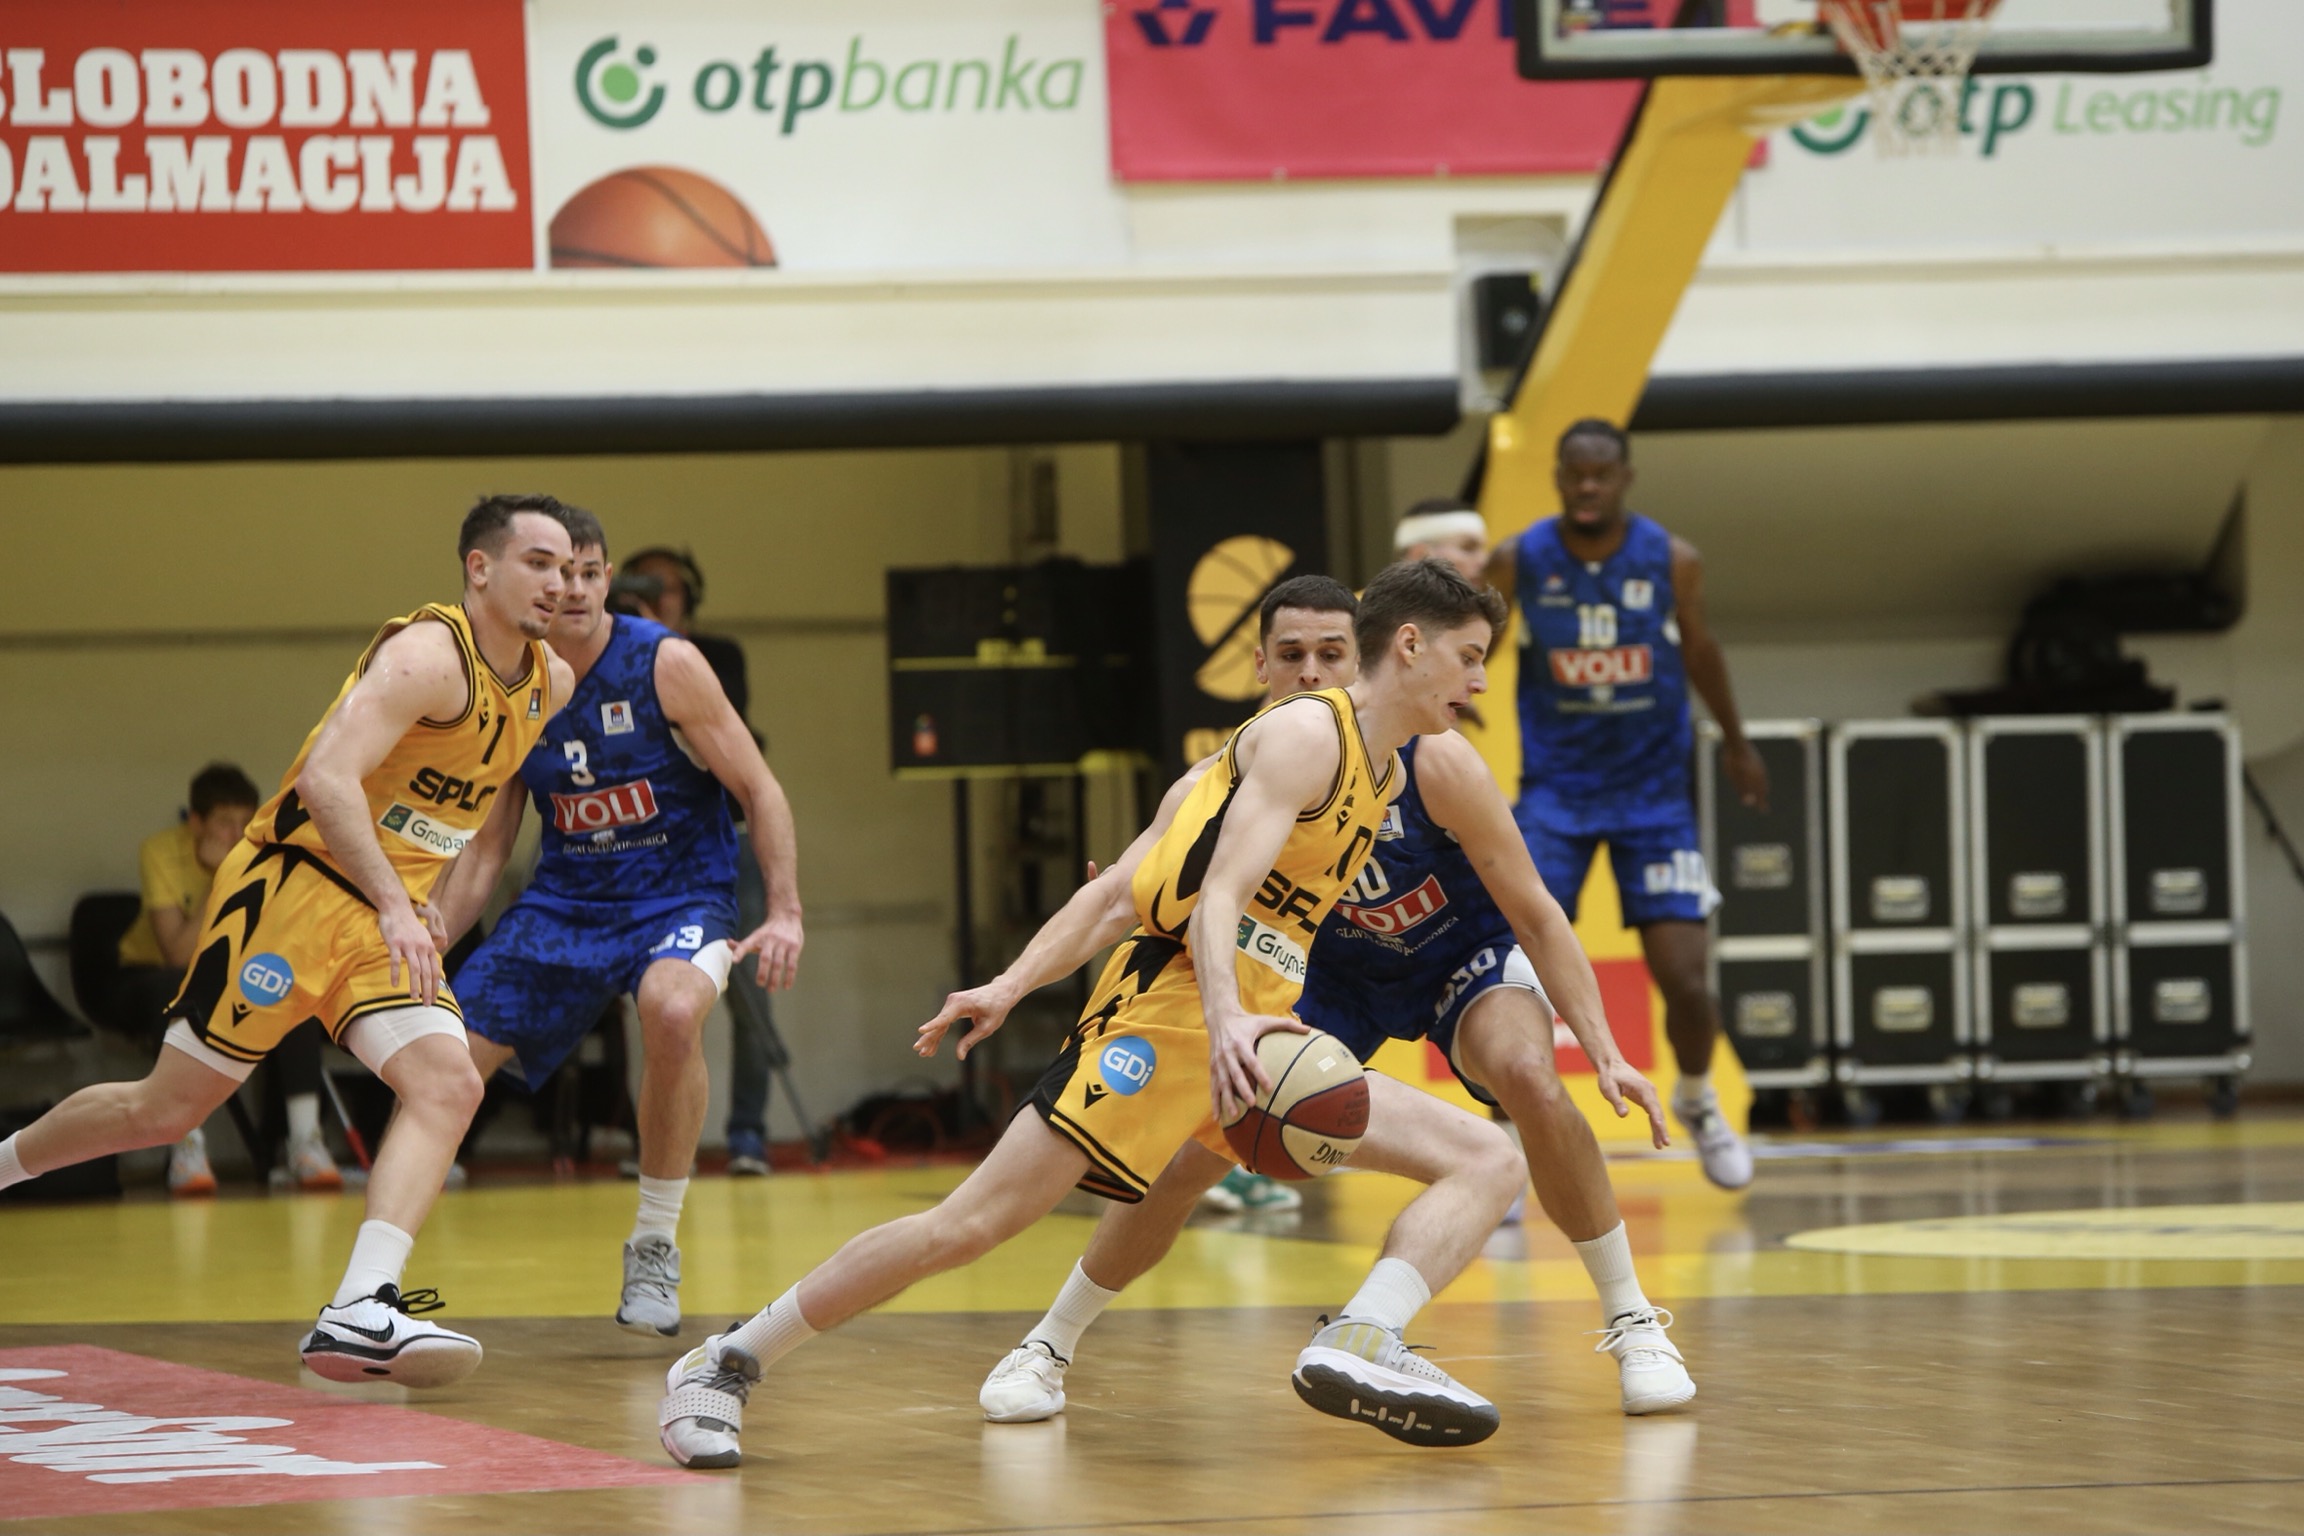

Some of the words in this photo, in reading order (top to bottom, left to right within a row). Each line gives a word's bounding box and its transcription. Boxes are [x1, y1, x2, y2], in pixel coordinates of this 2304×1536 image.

[0, 47, 489, 128] LOBODNA
[2053, 76, 2281, 147] Leasing
[1577, 603, 1618, 647] 10
[1556, 648, 1646, 685] VOLI
[481, 714, 507, 765] 1
[564, 739, 595, 787] 3
[558, 787, 646, 830] VOLI
[411, 819, 471, 852] Groupa
[676, 925, 704, 950] 3
[243, 962, 293, 998] GDi
[1103, 1046, 1154, 1087] GDi
